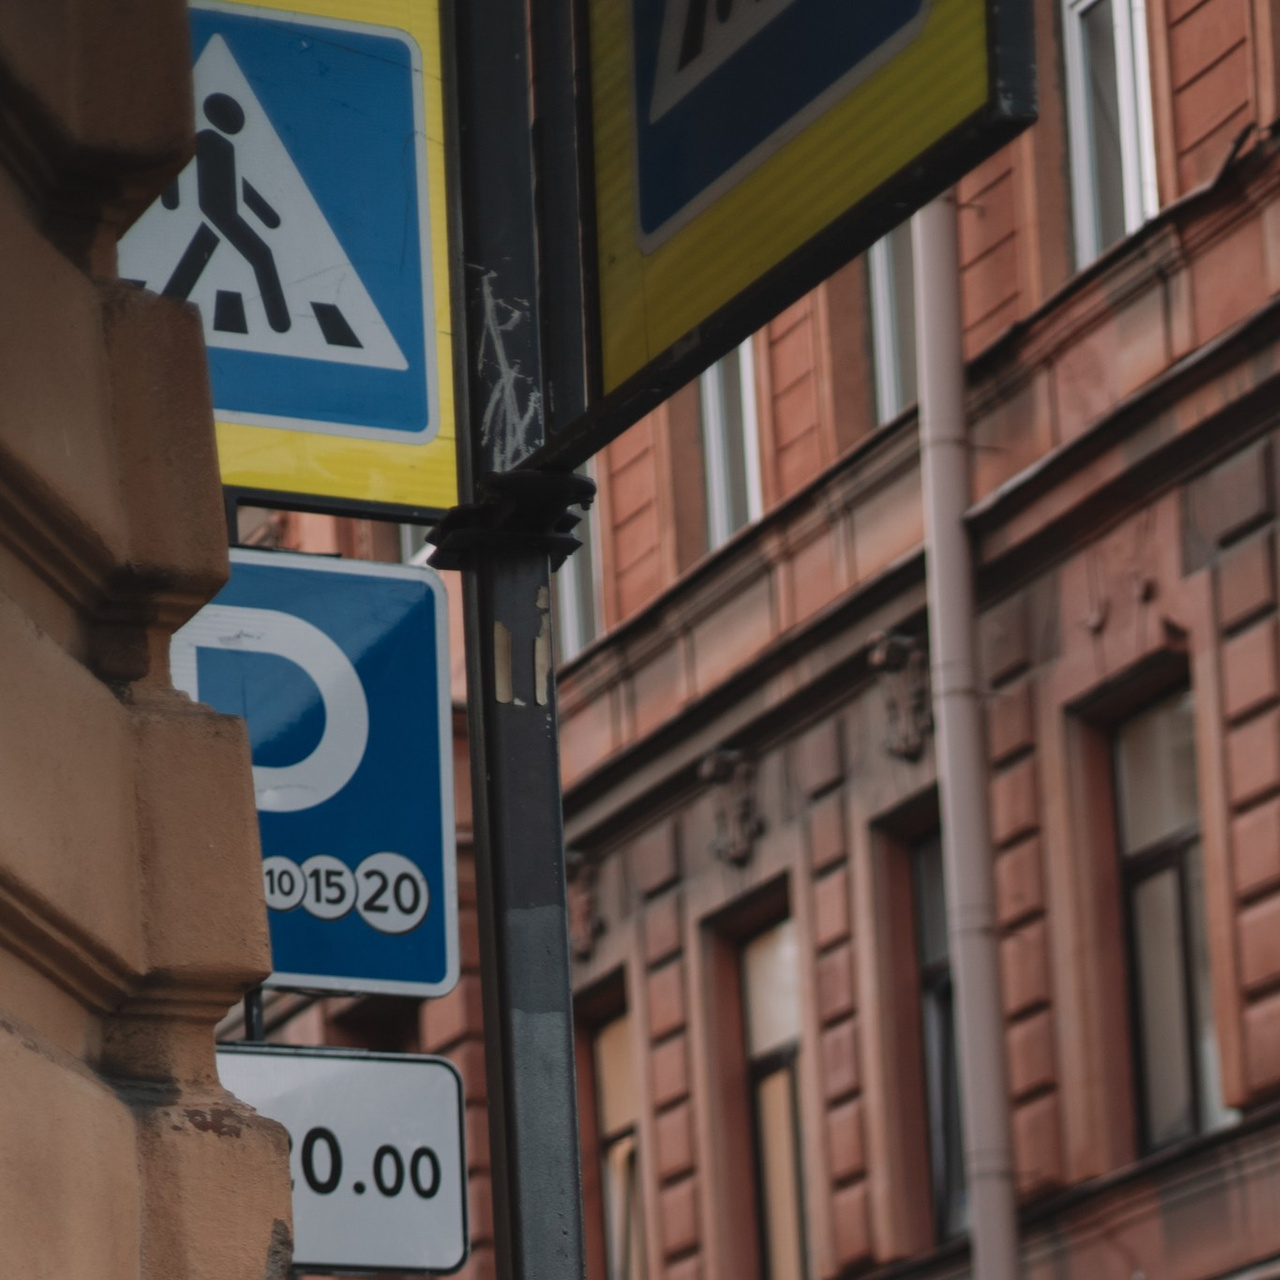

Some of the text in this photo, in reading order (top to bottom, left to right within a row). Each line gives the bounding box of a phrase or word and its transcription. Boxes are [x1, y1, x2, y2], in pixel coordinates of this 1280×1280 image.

[265, 868, 420, 915] 10 15 20
[290, 1126, 441, 1199] 0.00
